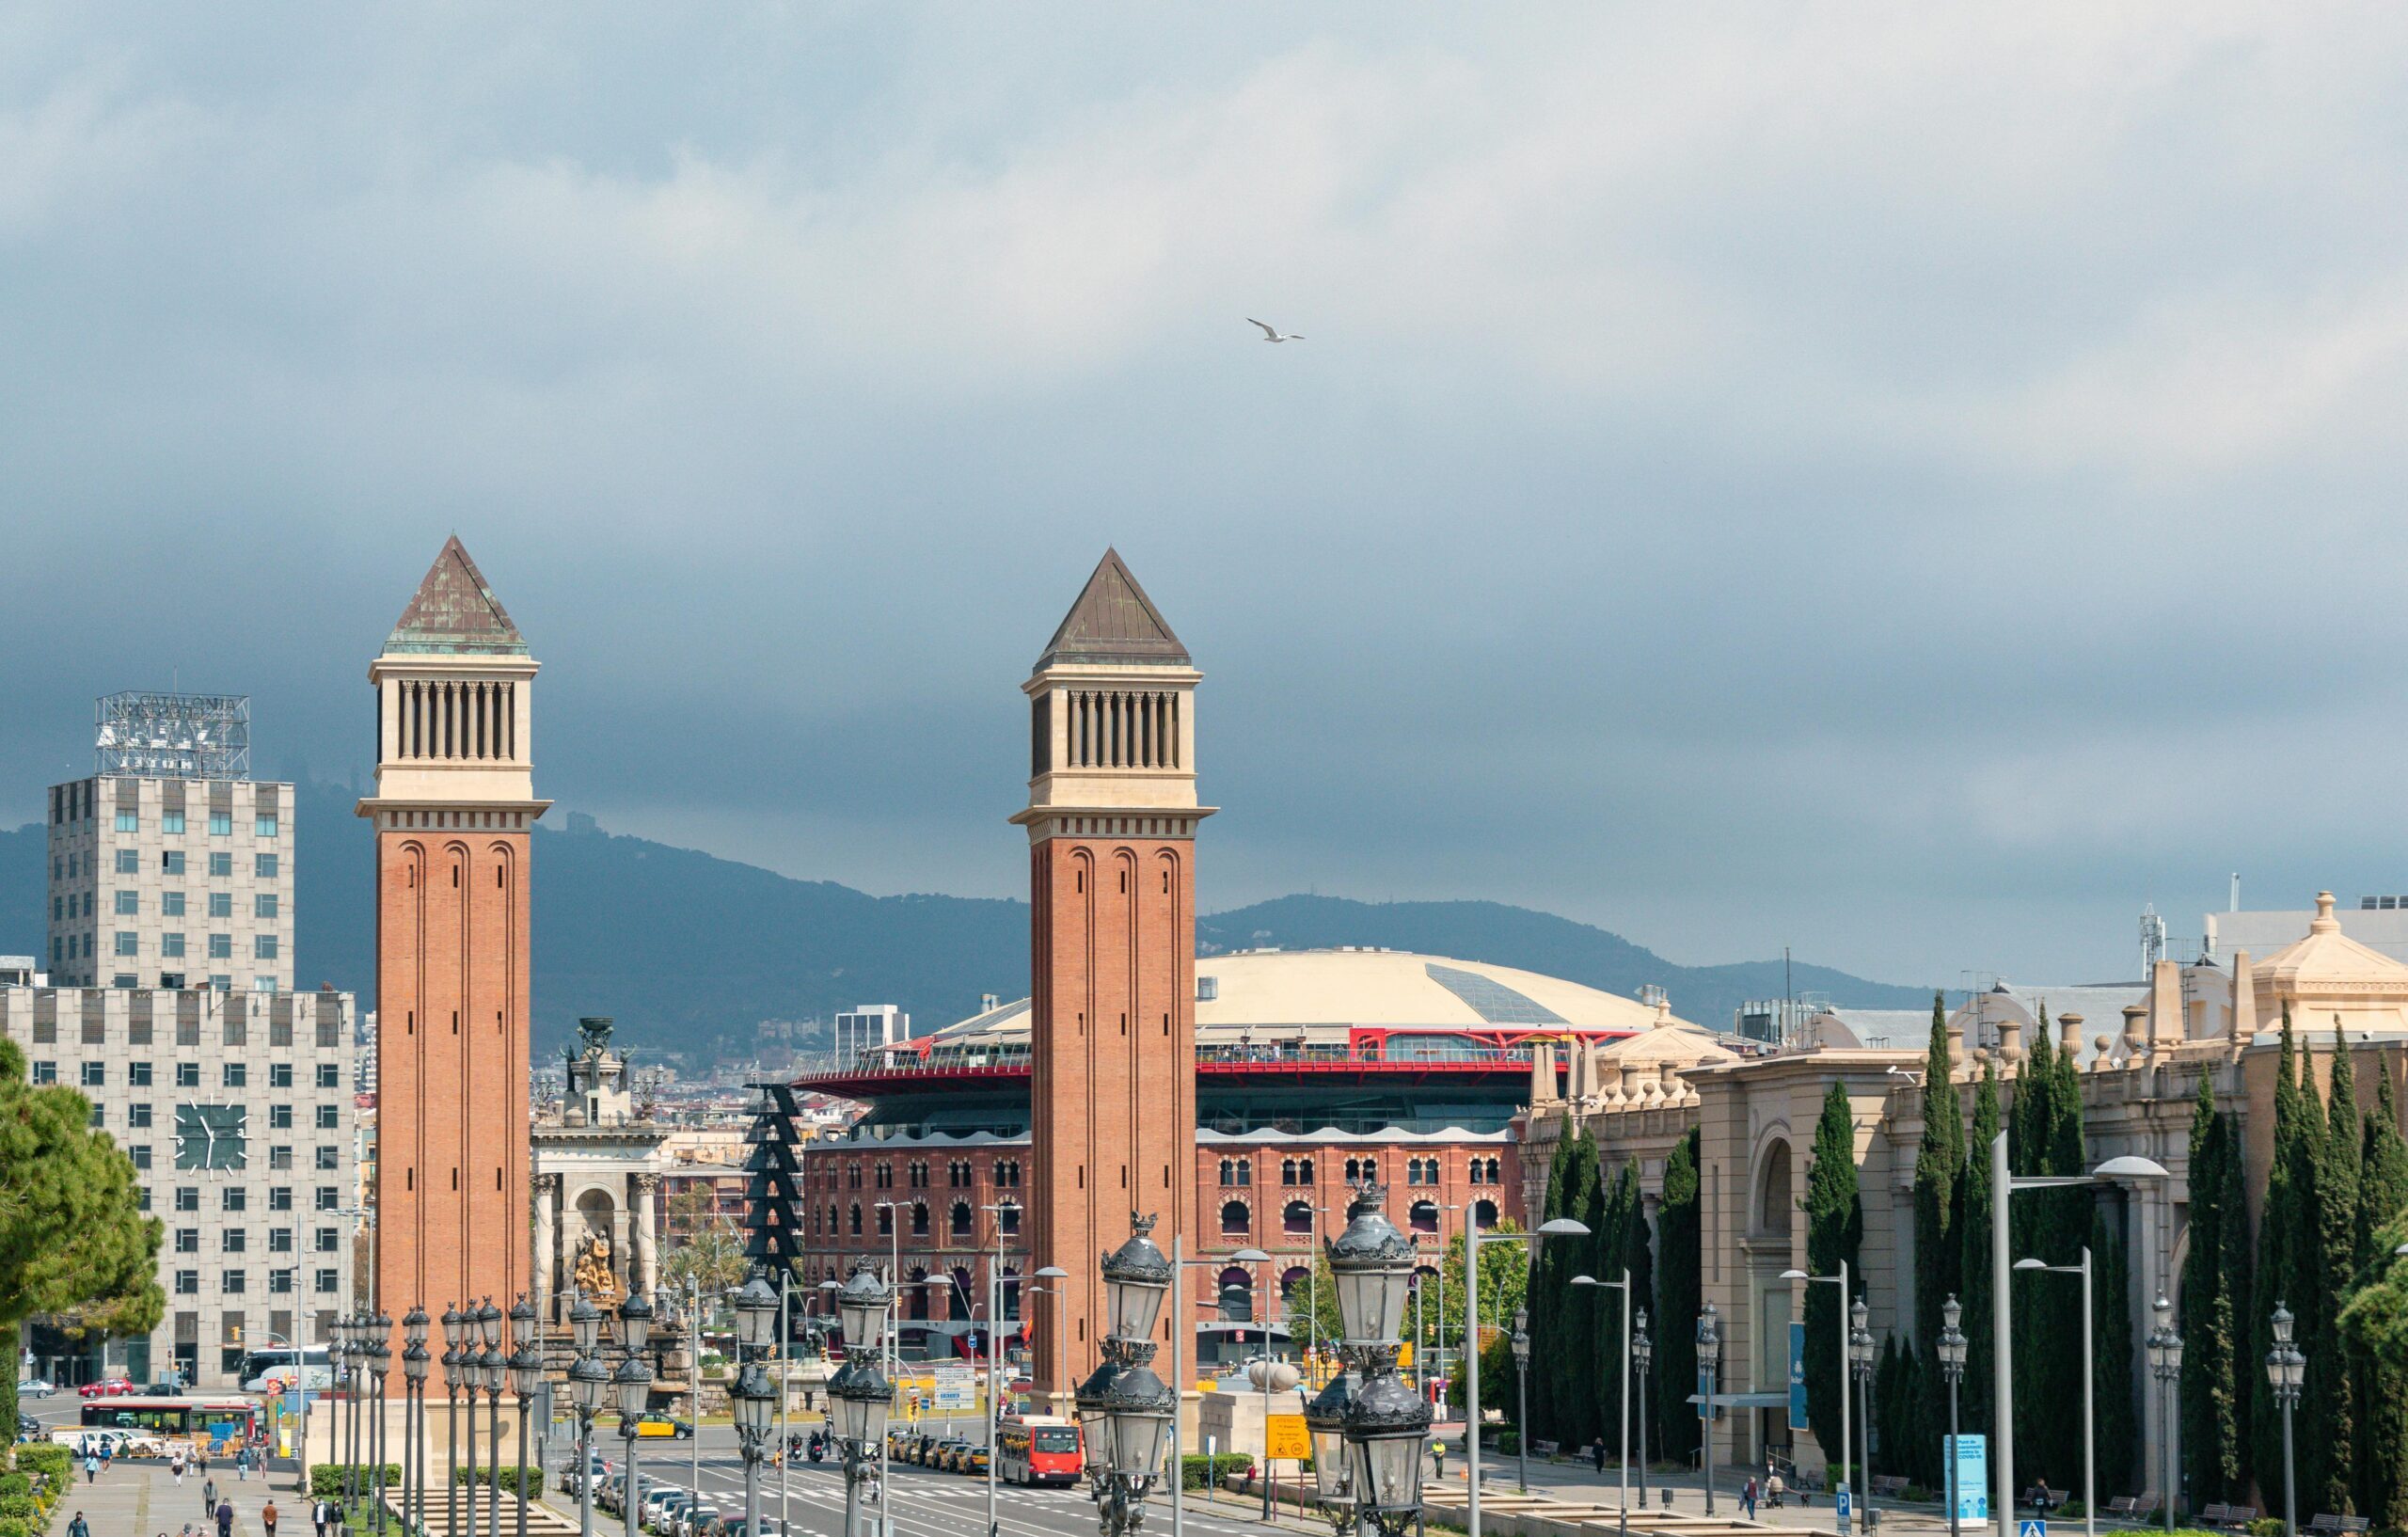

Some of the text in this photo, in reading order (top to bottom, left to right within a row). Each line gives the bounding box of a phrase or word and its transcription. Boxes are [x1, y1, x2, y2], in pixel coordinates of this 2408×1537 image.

[139, 695, 235, 710] CATALONIA
[177, 1138, 184, 1147] 9
[1839, 1495, 1848, 1513] P
